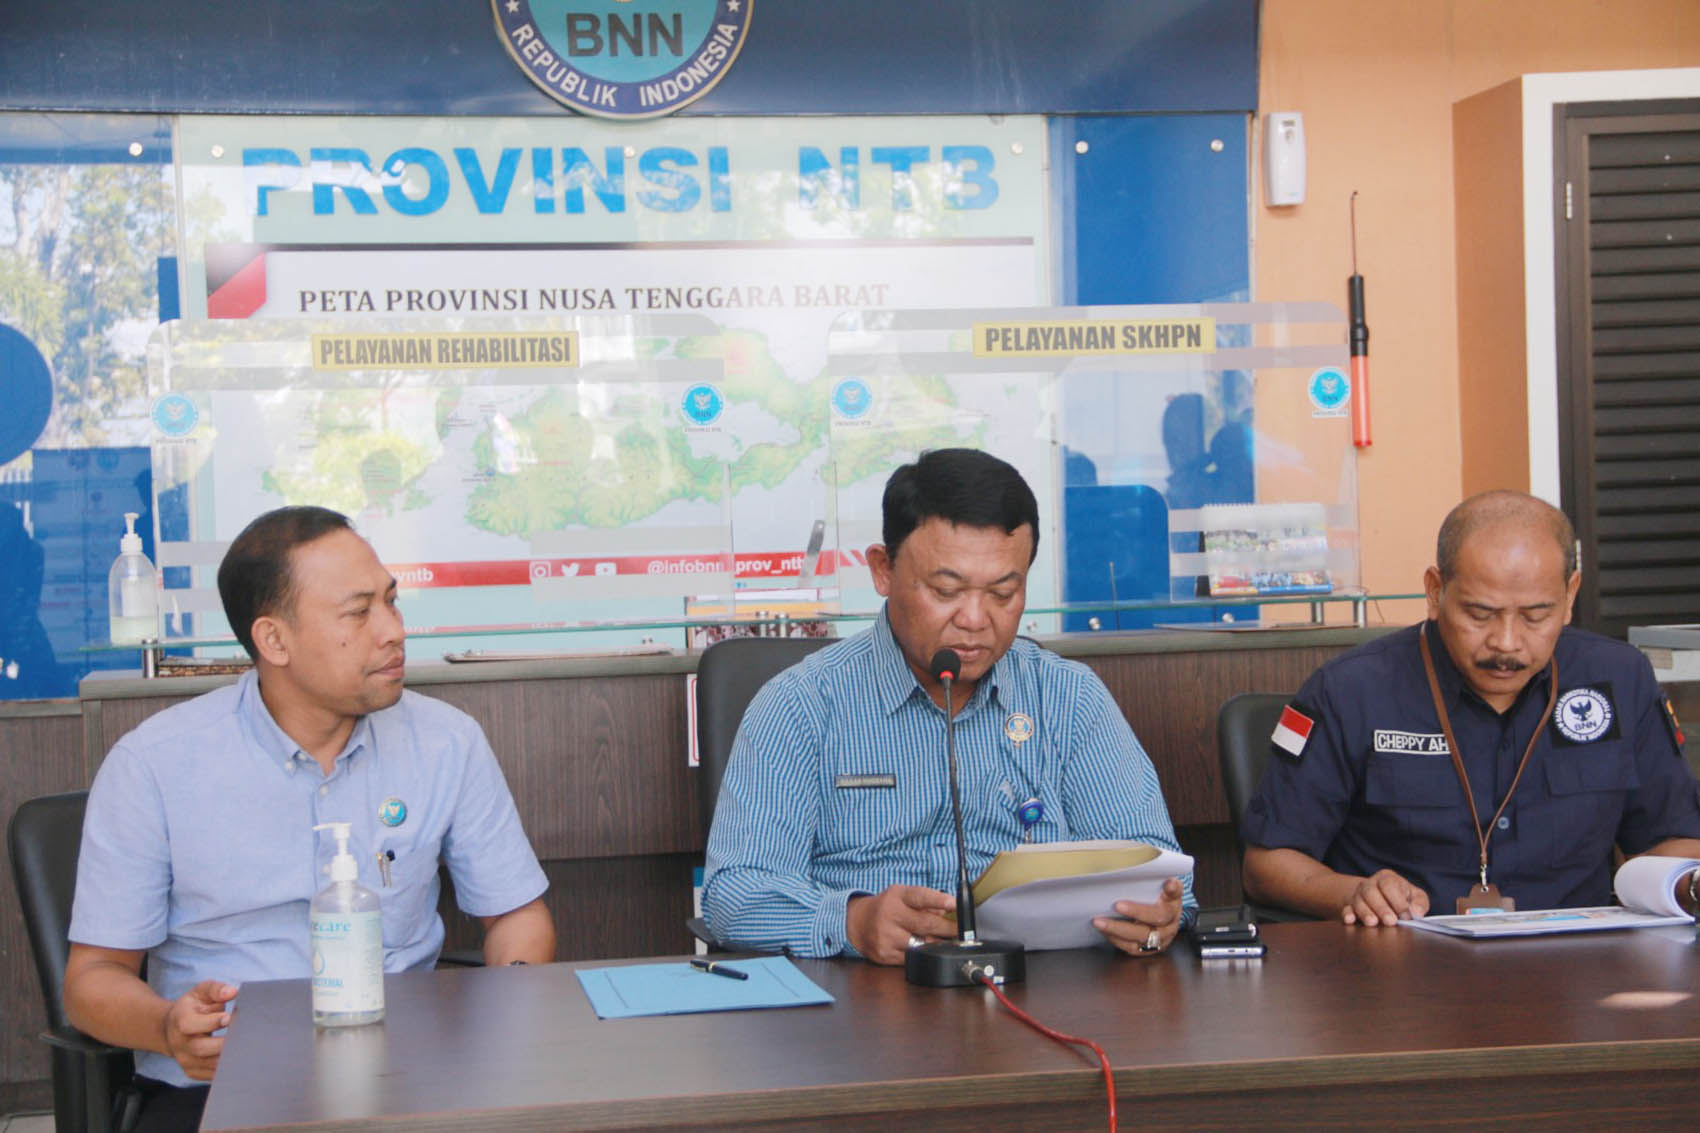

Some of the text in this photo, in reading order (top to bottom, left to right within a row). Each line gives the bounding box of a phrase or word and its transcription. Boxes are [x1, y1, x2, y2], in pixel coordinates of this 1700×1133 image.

[566, 13, 683, 57] BNN
[511, 21, 739, 107] REPUBLIK INDONESIA
[242, 146, 732, 216] PROVINSI
[299, 283, 890, 313] PETA PROVINSI NUSA TENGGARA BARAT
[320, 336, 571, 365] PELAYANAN REHABILITASI
[985, 323, 1202, 352] PELAYANAN SKHPN
[1378, 733, 1425, 751] CHEPPY
